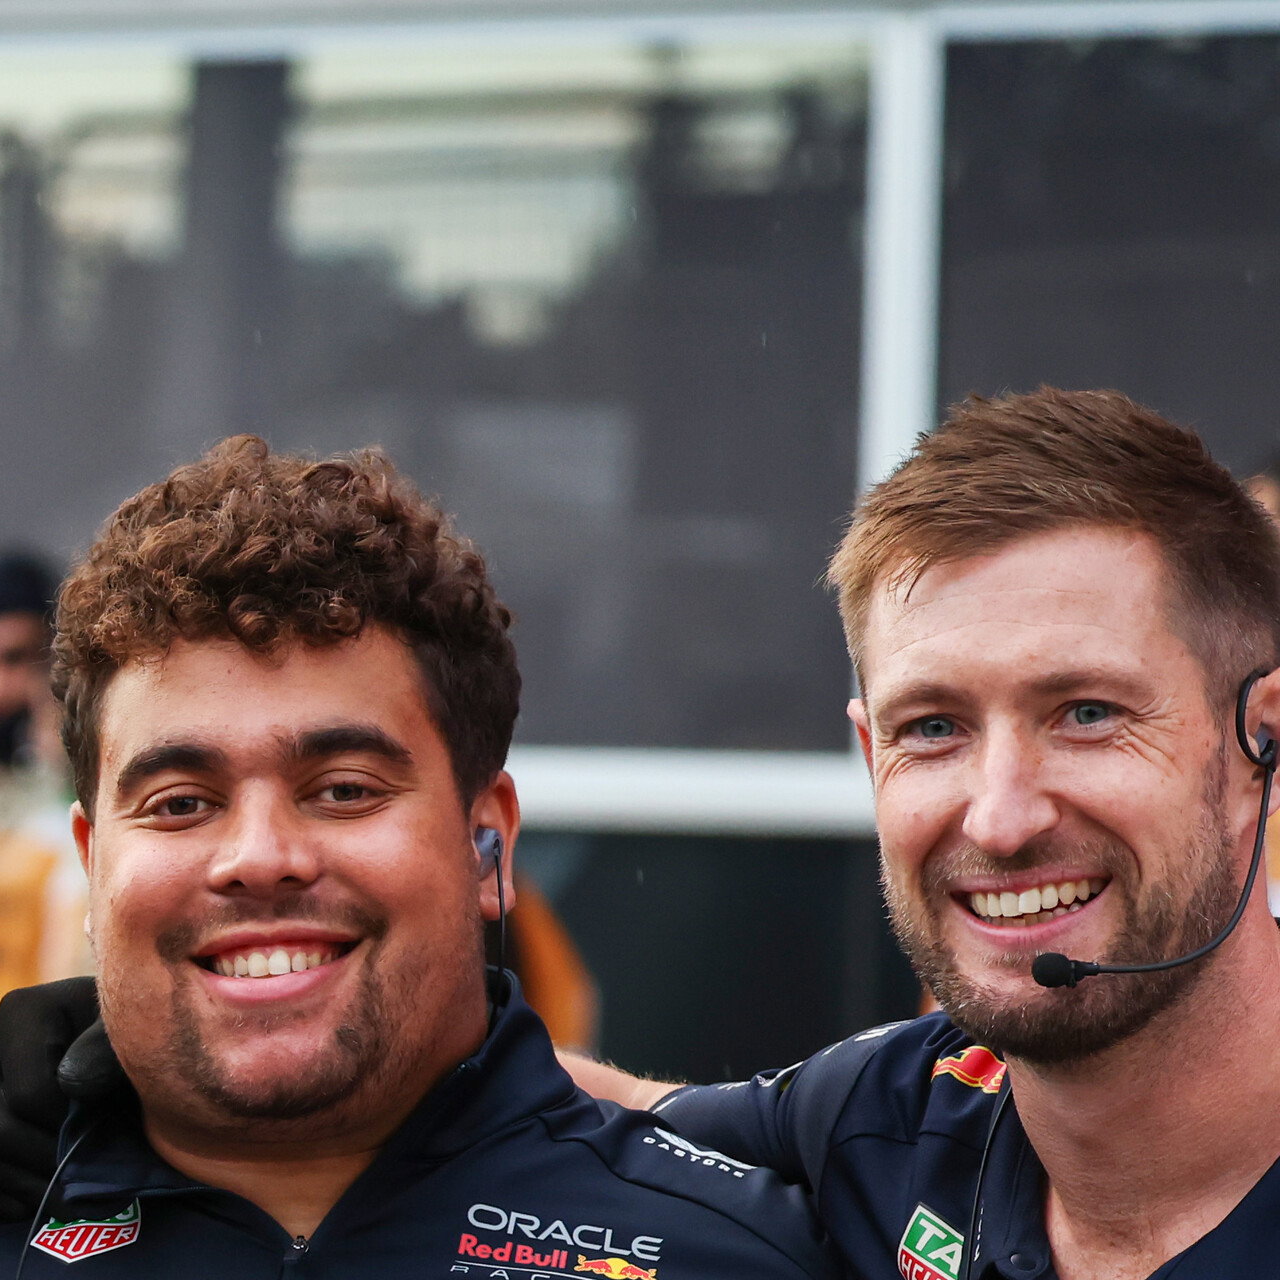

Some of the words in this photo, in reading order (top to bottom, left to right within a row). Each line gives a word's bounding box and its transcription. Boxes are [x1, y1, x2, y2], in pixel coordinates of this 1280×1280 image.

[39, 1226, 135, 1256] HEUER
[458, 1233, 513, 1262] Red
[515, 1244, 569, 1269] Bull
[467, 1203, 664, 1261] ORACLE
[914, 1218, 963, 1274] TA
